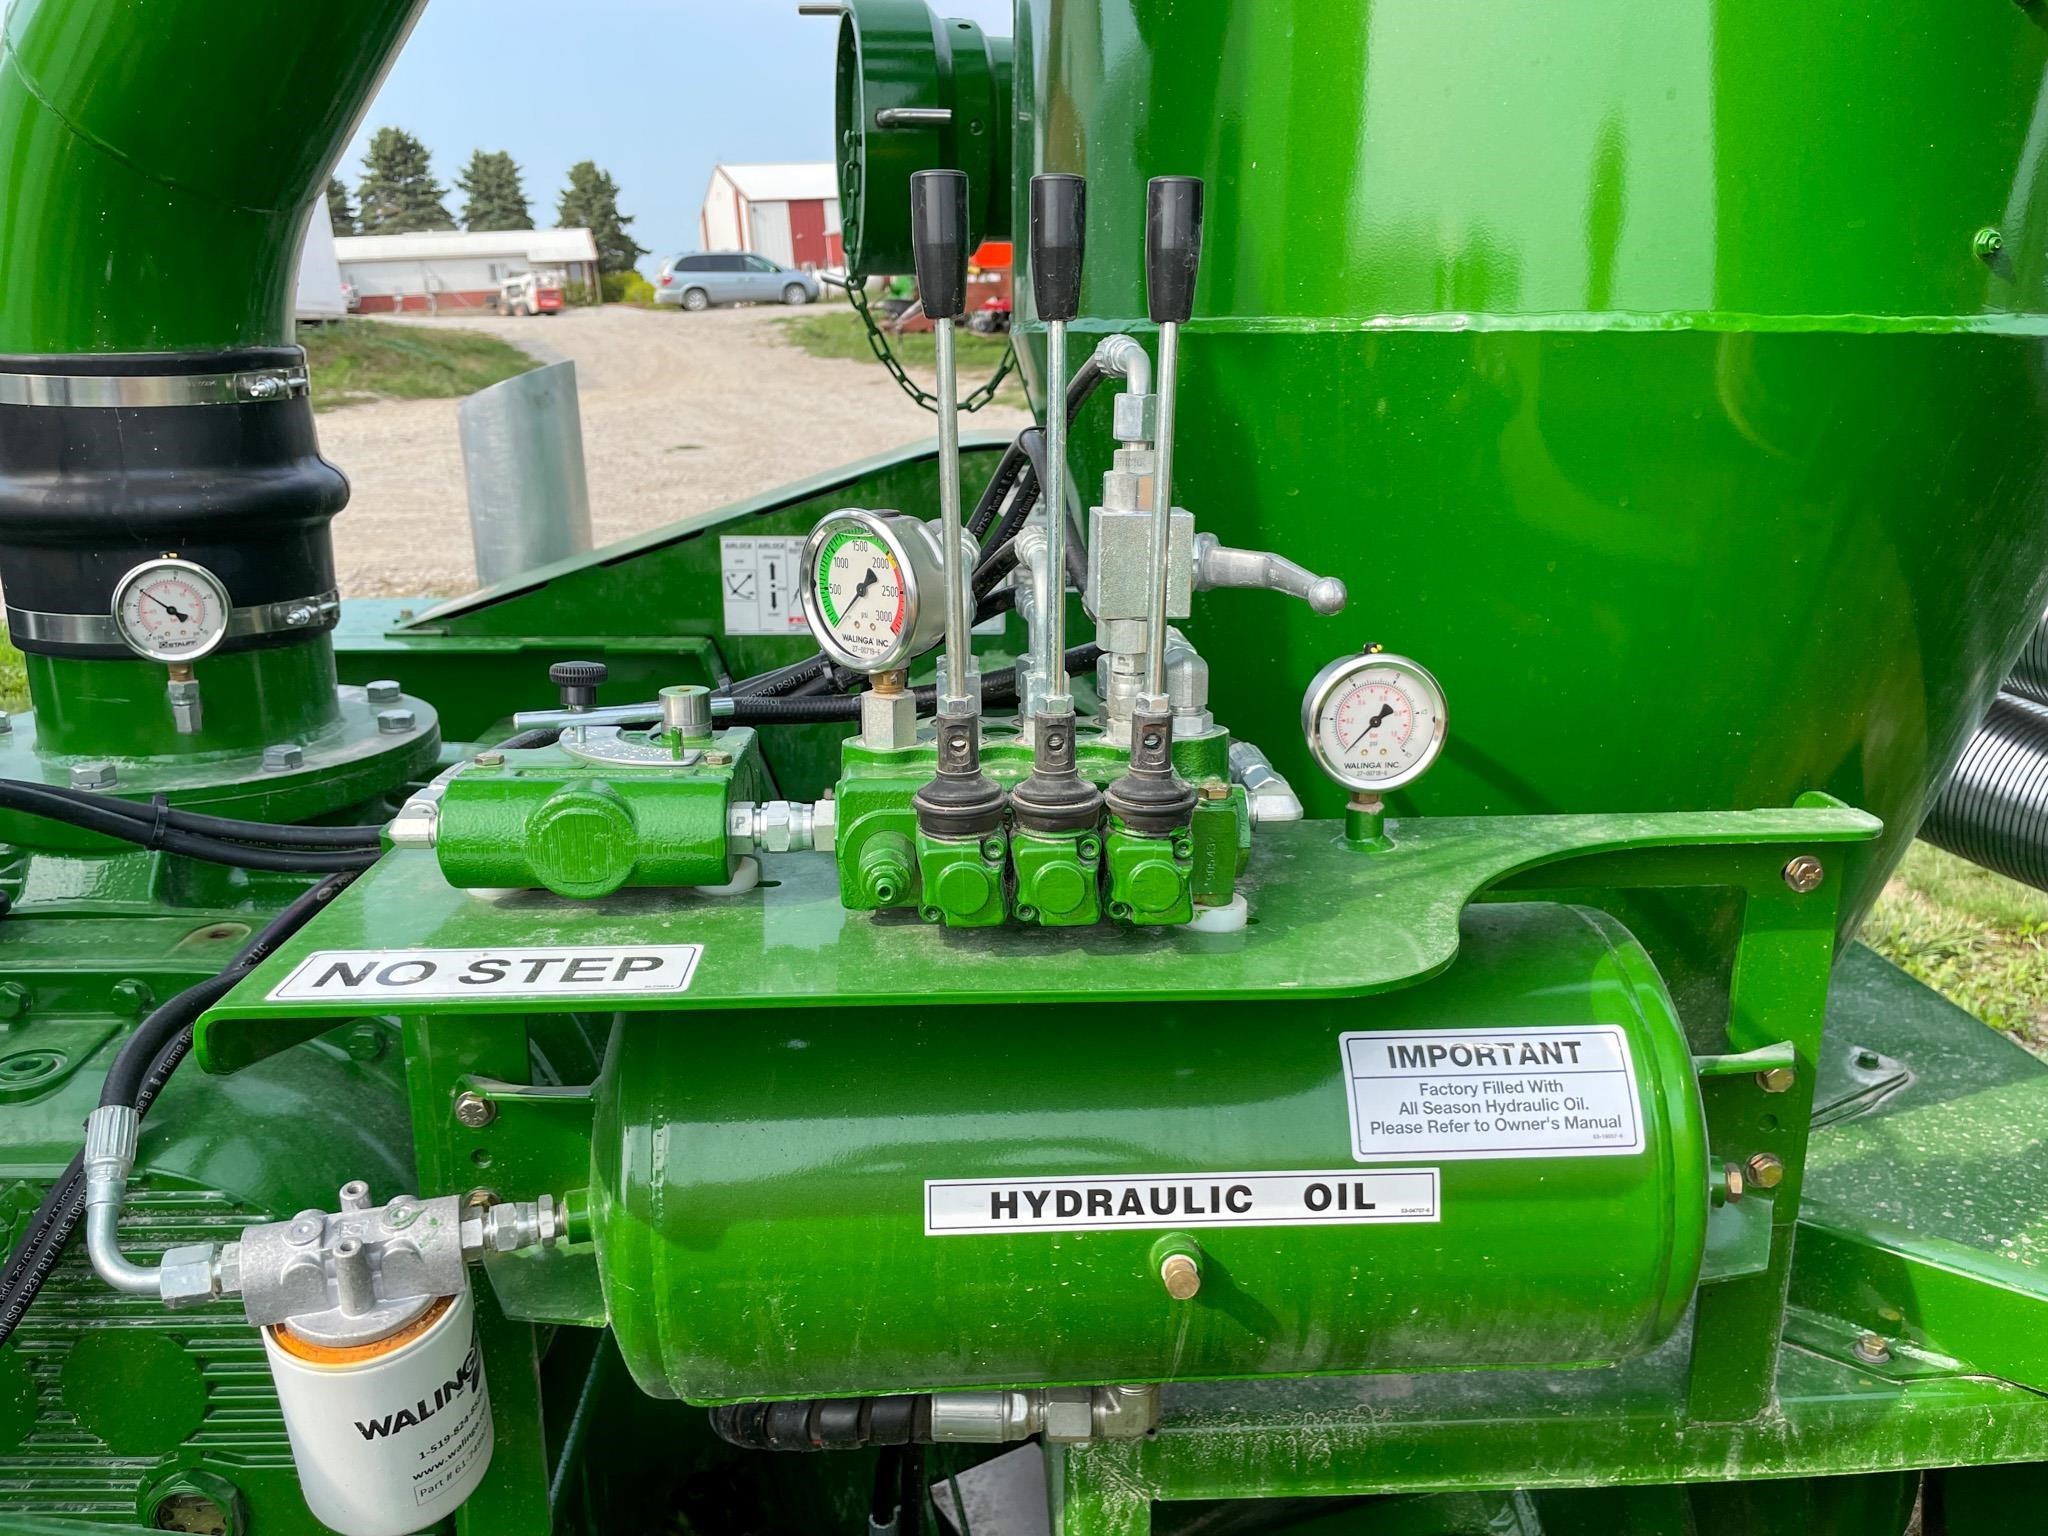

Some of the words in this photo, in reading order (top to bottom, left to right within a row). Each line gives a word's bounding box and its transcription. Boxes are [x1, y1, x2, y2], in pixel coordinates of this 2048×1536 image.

[852, 540, 868, 552] 1500
[834, 556, 849, 569] 1000
[872, 557, 890, 569] 2000
[829, 583, 842, 596] 500
[881, 585, 899, 598] 2500
[875, 609, 893, 622] 3000
[842, 633, 874, 645] WALINGA
[1344, 761, 1382, 769] WALINGA
[312, 960, 437, 987] NO
[458, 956, 664, 985] STEP
[158, 1043, 186, 1074] Flame
[1387, 1041, 1582, 1069] IMPORTANT
[1419, 1081, 1478, 1099] Factory
[1483, 1080, 1524, 1095] Filled
[1529, 1079, 1564, 1094] With
[1399, 1101, 1418, 1116] All
[1423, 1100, 1481, 1115] Season
[1486, 1098, 1559, 1117] Hydraulic
[1564, 1096, 1589, 1111] Oil.
[1371, 1120, 1423, 1136] Please
[1427, 1118, 1469, 1134] Refer
[1475, 1118, 1490, 1133] to
[1495, 1116, 1560, 1132] Owner's
[1565, 1114, 1622, 1129] Manual
[991, 1184, 1254, 1220] HYDRAULIC
[1303, 1181, 1376, 1212] OIL
[4, 1304, 23, 1323] ISO
[16, 1270, 43, 1304] 11237
[37, 1248, 56, 1271] R17
[55, 1221, 74, 1242] SAE
[354, 1347, 477, 1441] WALING
[420, 1479, 443, 1497] Part
